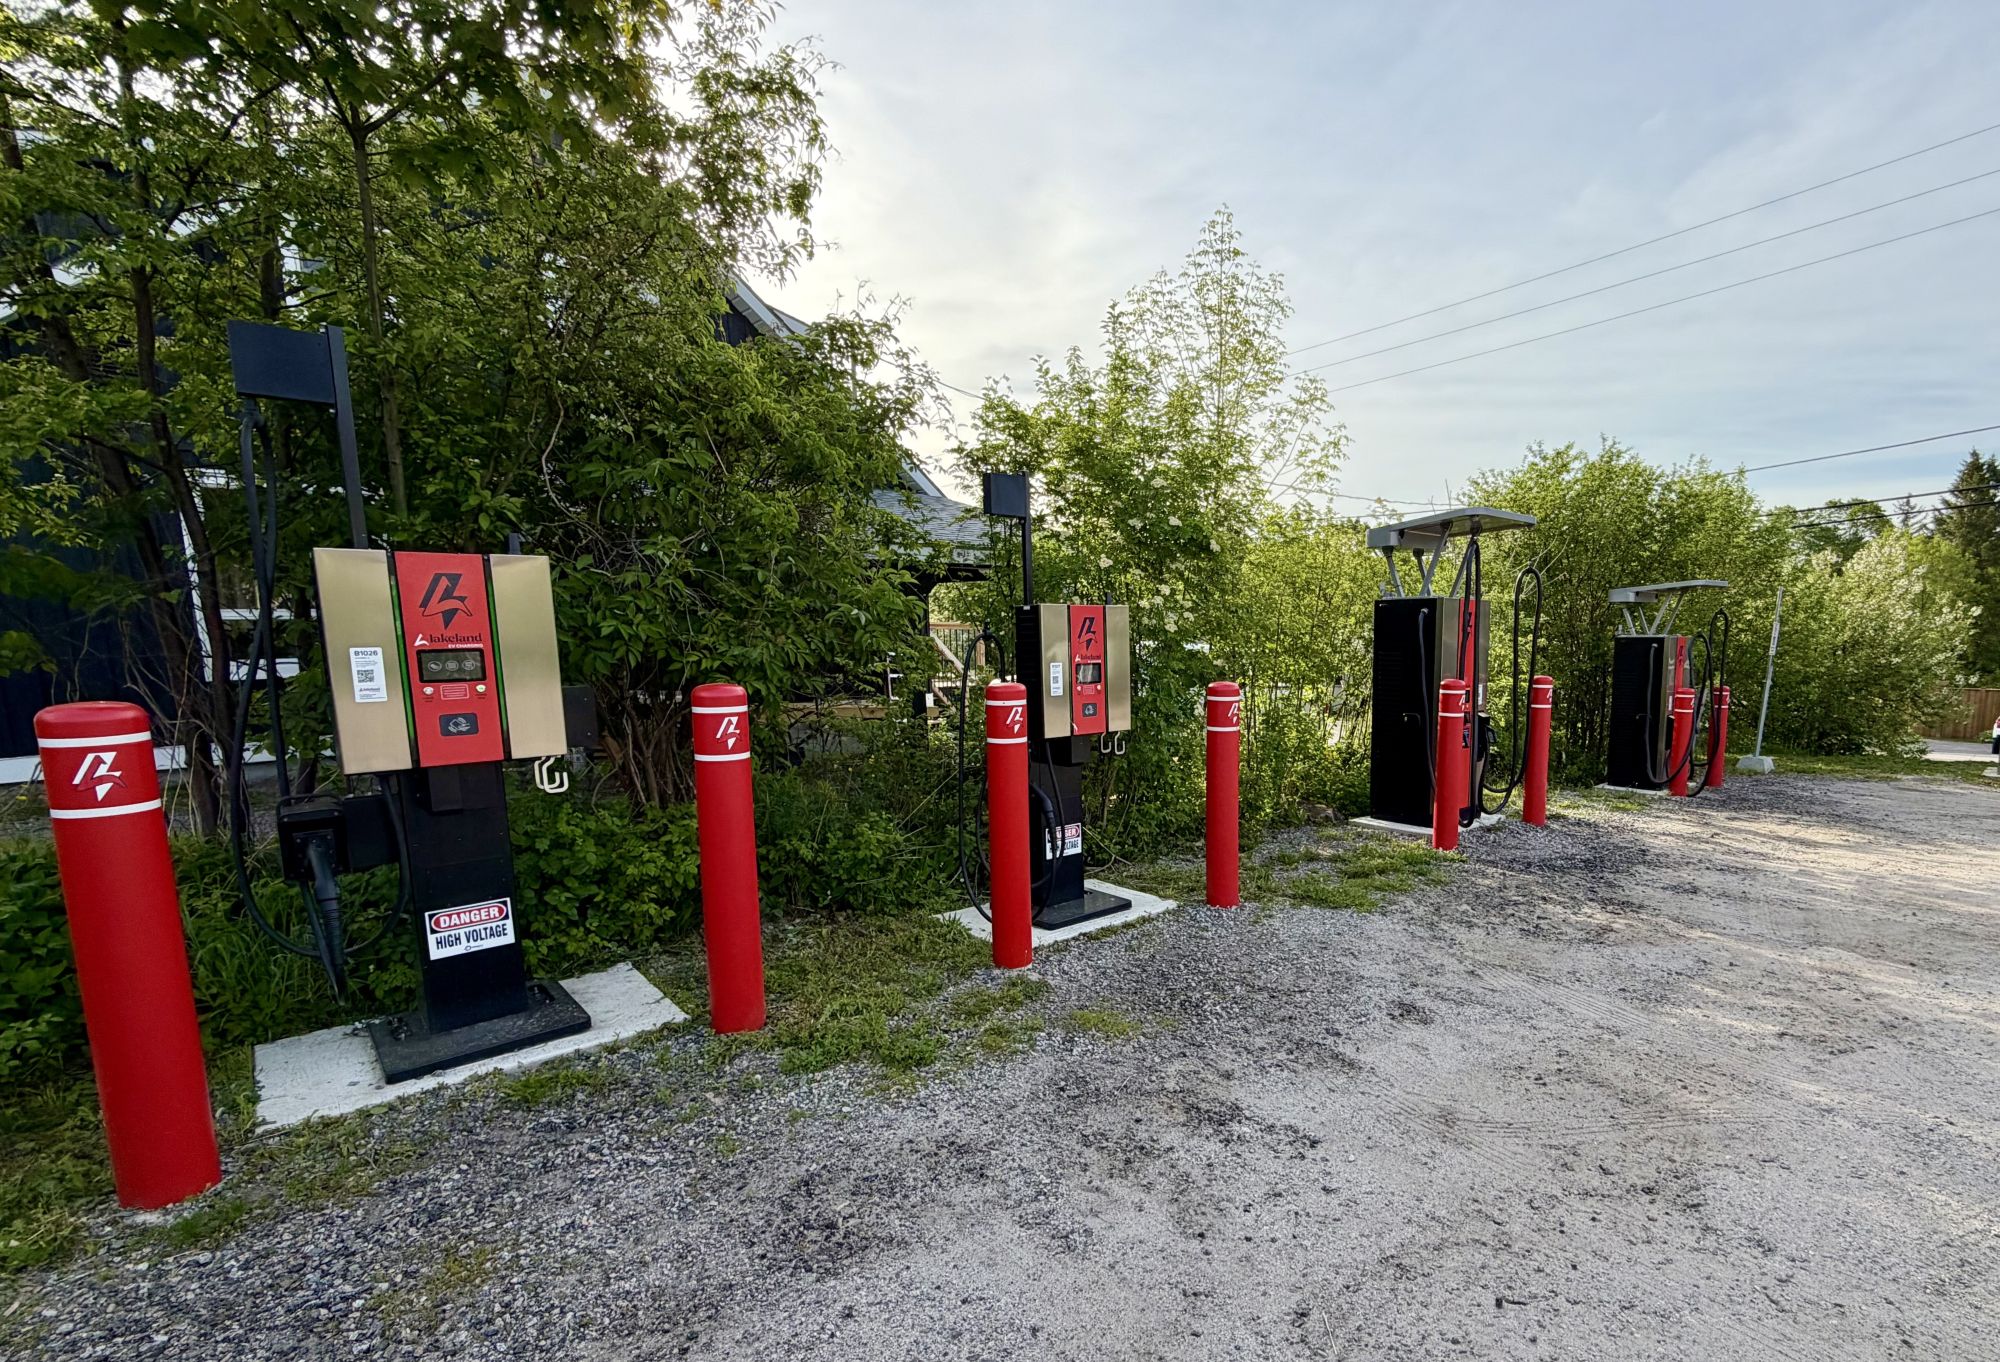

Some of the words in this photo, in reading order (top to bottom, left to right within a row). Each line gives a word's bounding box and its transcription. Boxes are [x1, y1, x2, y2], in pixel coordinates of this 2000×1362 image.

[429, 633, 483, 643] lakeland
[439, 906, 500, 928] DANGER
[435, 932, 462, 950] HIGH
[464, 923, 508, 943] VOLTAGE
